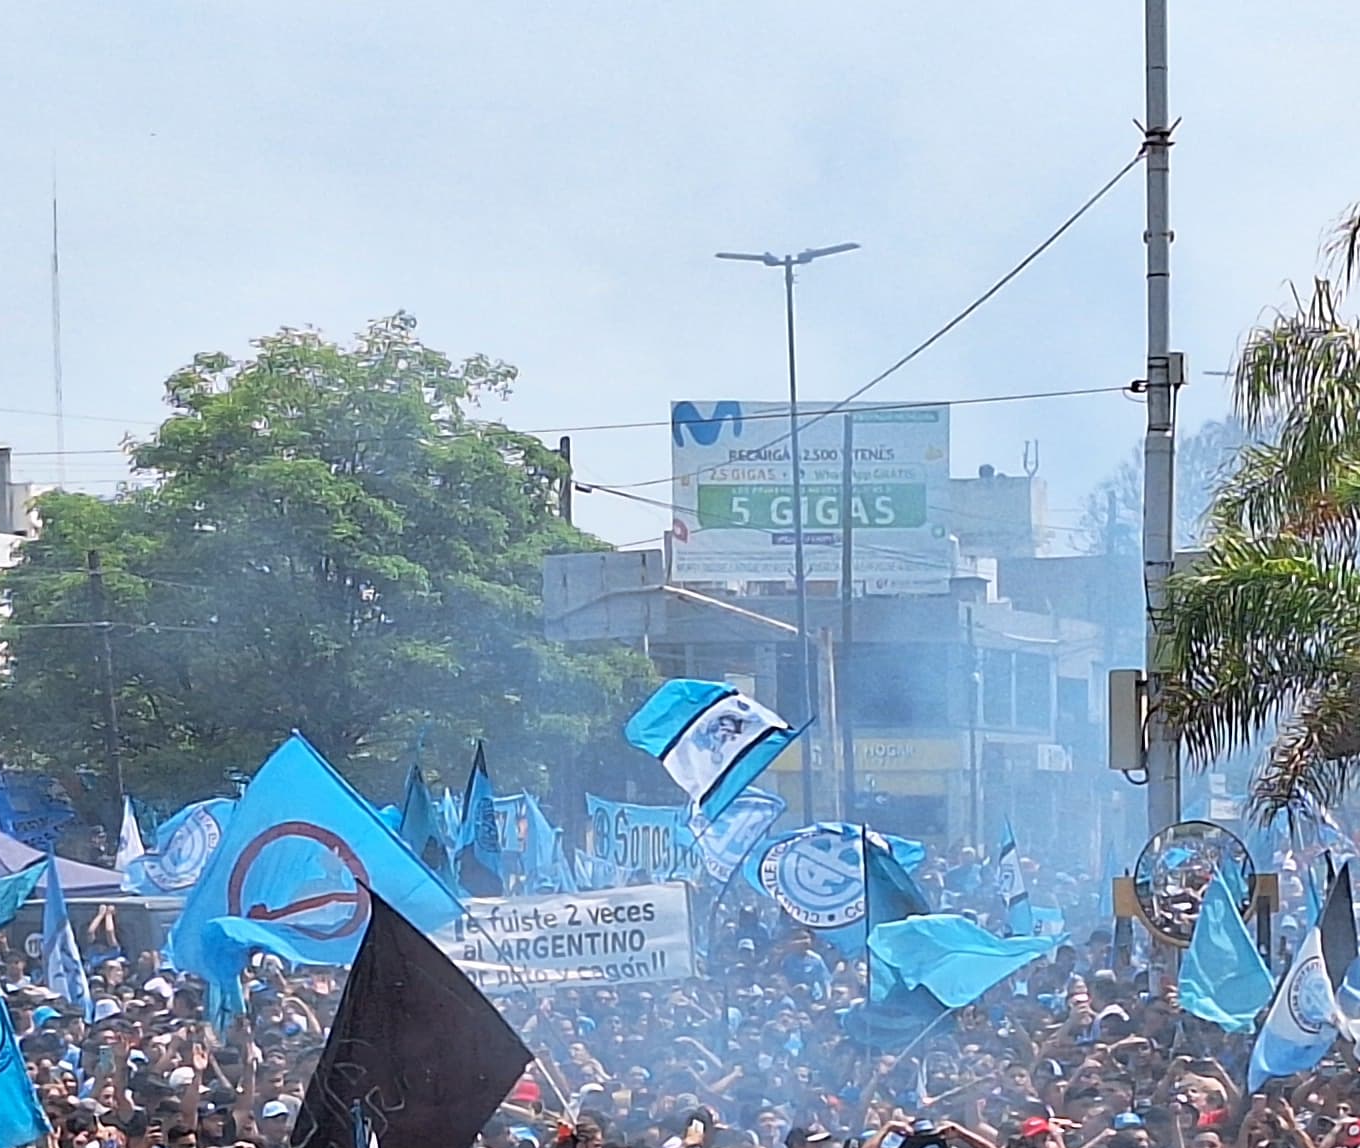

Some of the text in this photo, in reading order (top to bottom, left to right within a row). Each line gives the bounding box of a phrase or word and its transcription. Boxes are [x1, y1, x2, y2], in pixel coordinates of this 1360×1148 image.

[731, 495, 895, 526] 5 GIGAS
[490, 905, 558, 933] fuiste
[564, 904, 581, 926] 2
[588, 901, 656, 925] veces
[463, 929, 646, 962] al ARGENTINO
